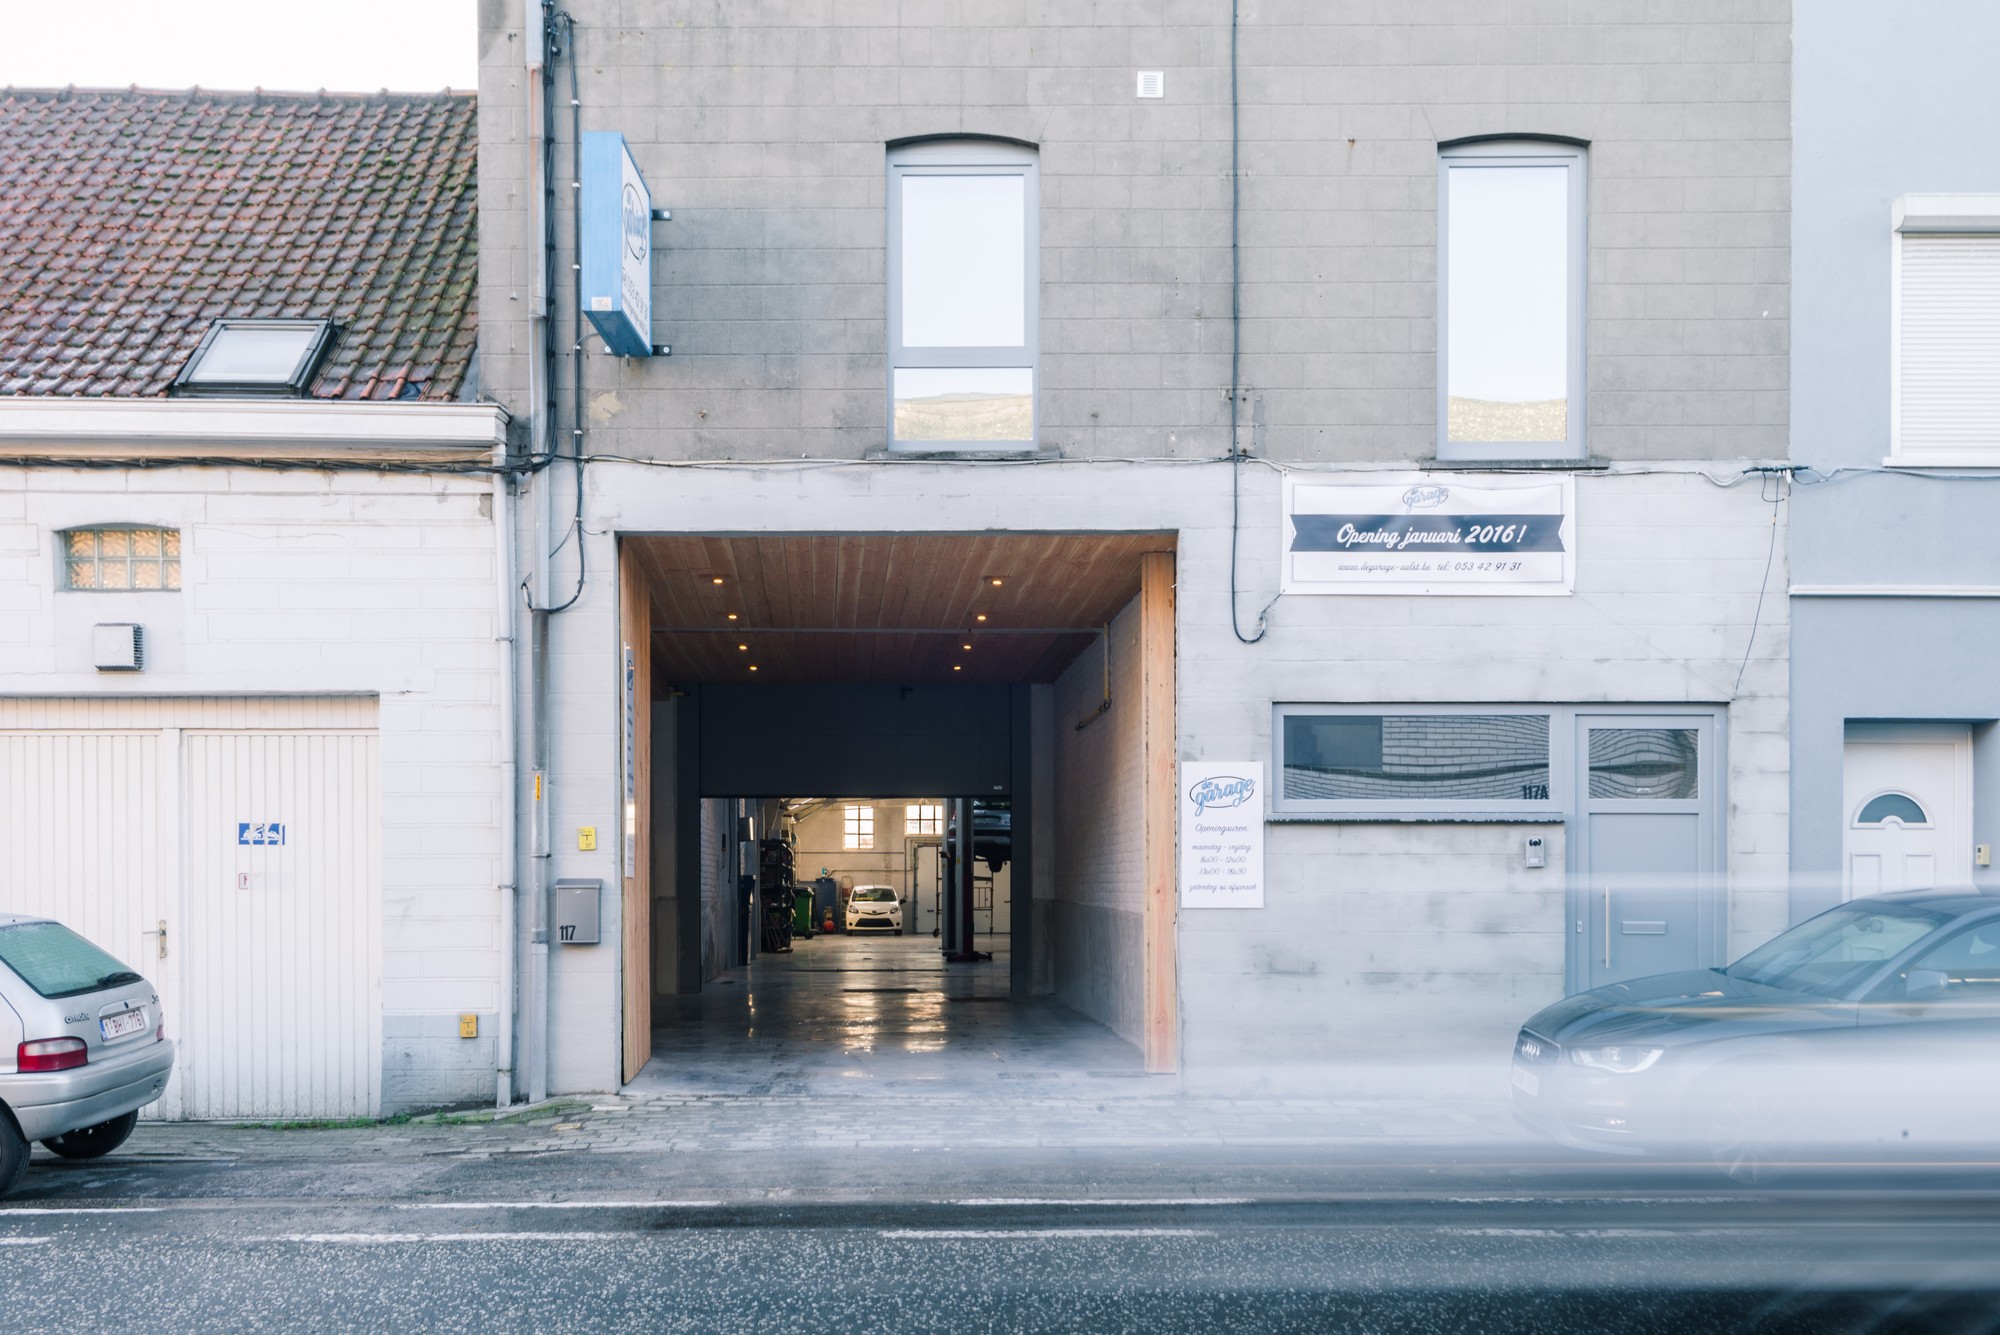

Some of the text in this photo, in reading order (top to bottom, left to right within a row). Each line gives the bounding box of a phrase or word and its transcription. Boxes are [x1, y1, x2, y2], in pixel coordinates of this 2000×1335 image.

[1406, 487, 1449, 513] garage
[1337, 523, 1400, 549] Opening
[1397, 527, 1461, 550] januari
[1454, 562, 1474, 571] 053
[1477, 562, 1492, 571] 42
[1495, 562, 1506, 571] 91
[1509, 562, 1522, 571] 31
[1202, 777, 1213, 790] de
[1194, 777, 1255, 817] garage
[1522, 785, 1549, 799] 117A
[1192, 843, 1222, 853] maandag
[559, 925, 576, 940] 117
